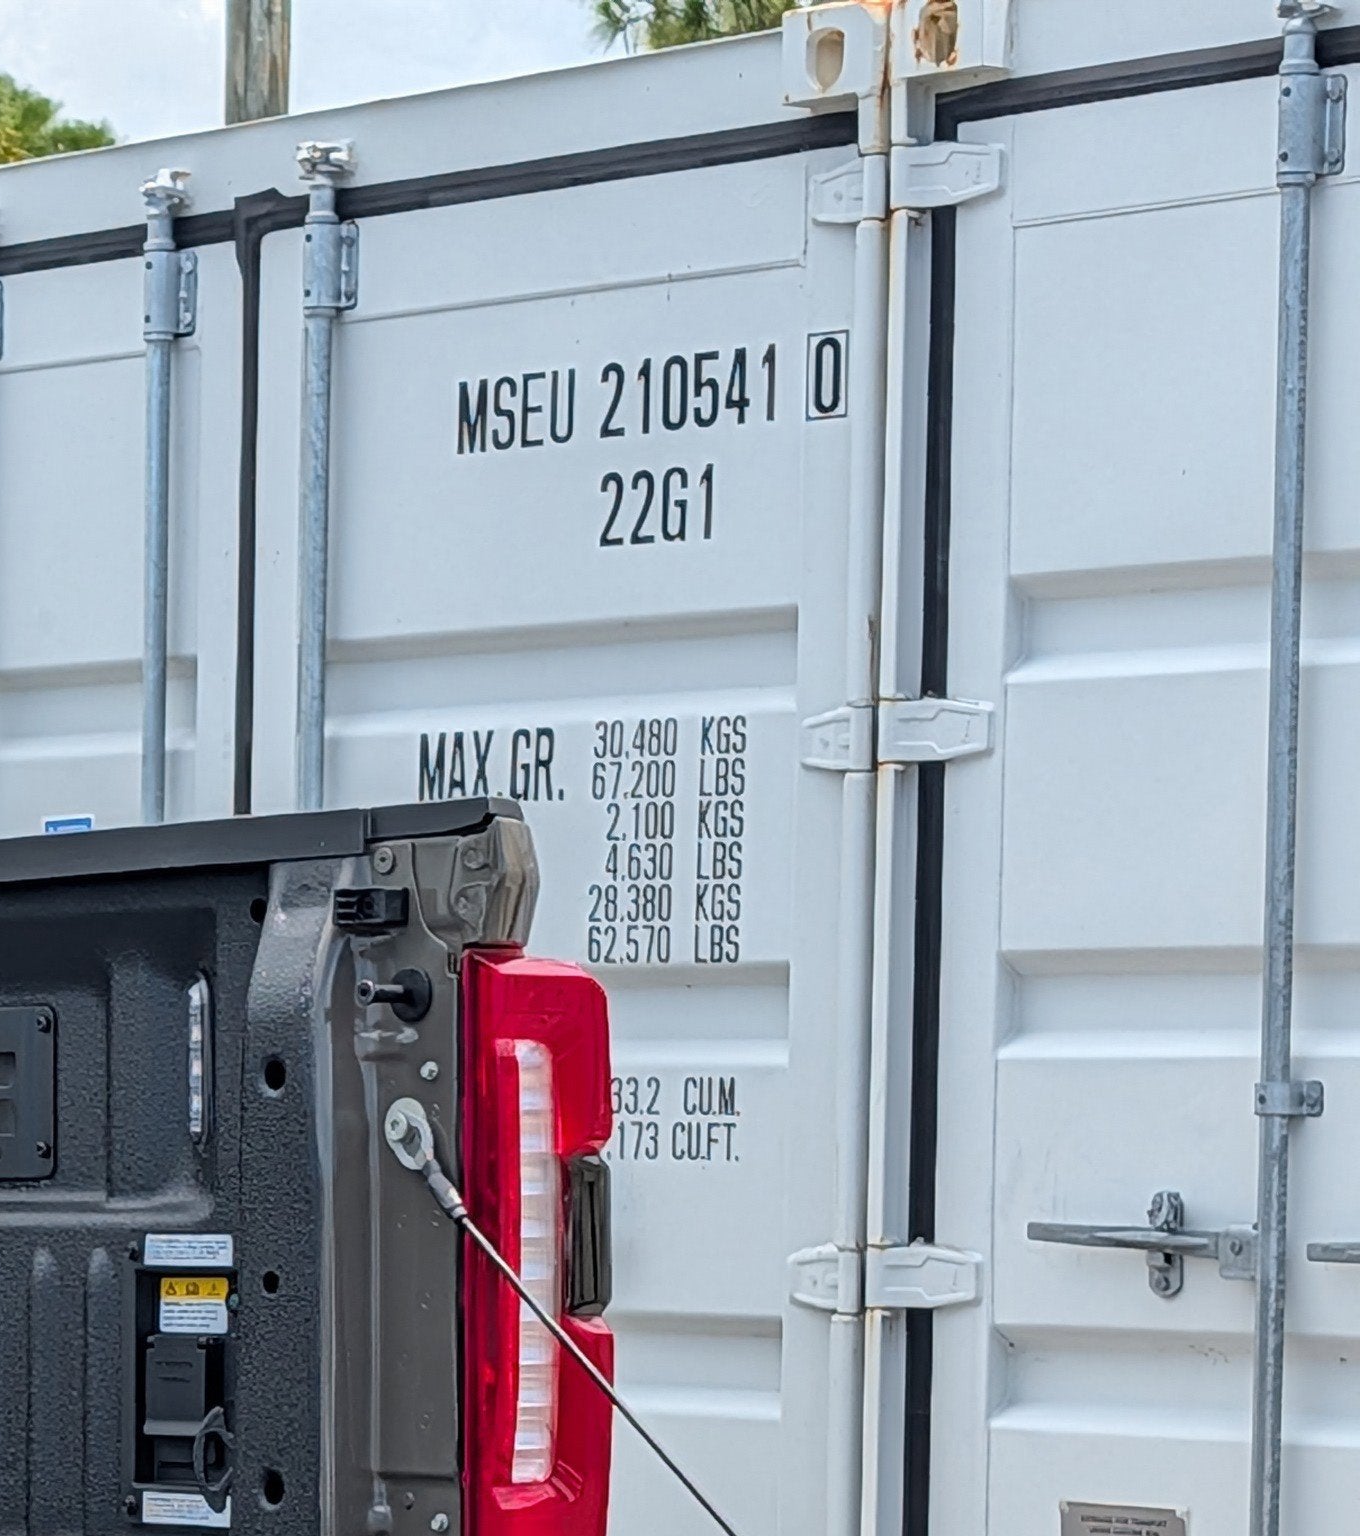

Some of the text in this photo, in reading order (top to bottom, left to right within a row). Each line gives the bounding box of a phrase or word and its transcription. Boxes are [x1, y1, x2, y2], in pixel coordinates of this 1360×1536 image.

[456, 336, 841, 455] MSEU 210541 0
[599, 463, 714, 547] 22G1
[701, 715, 747, 756] KGS
[510, 727, 565, 801] GR.
[699, 757, 746, 797] LBS
[698, 799, 744, 840] KGS
[696, 841, 743, 880] LBS
[695, 883, 741, 922] KGS
[694, 924, 740, 963] LBS
[610, 1076, 660, 1115] 33.2
